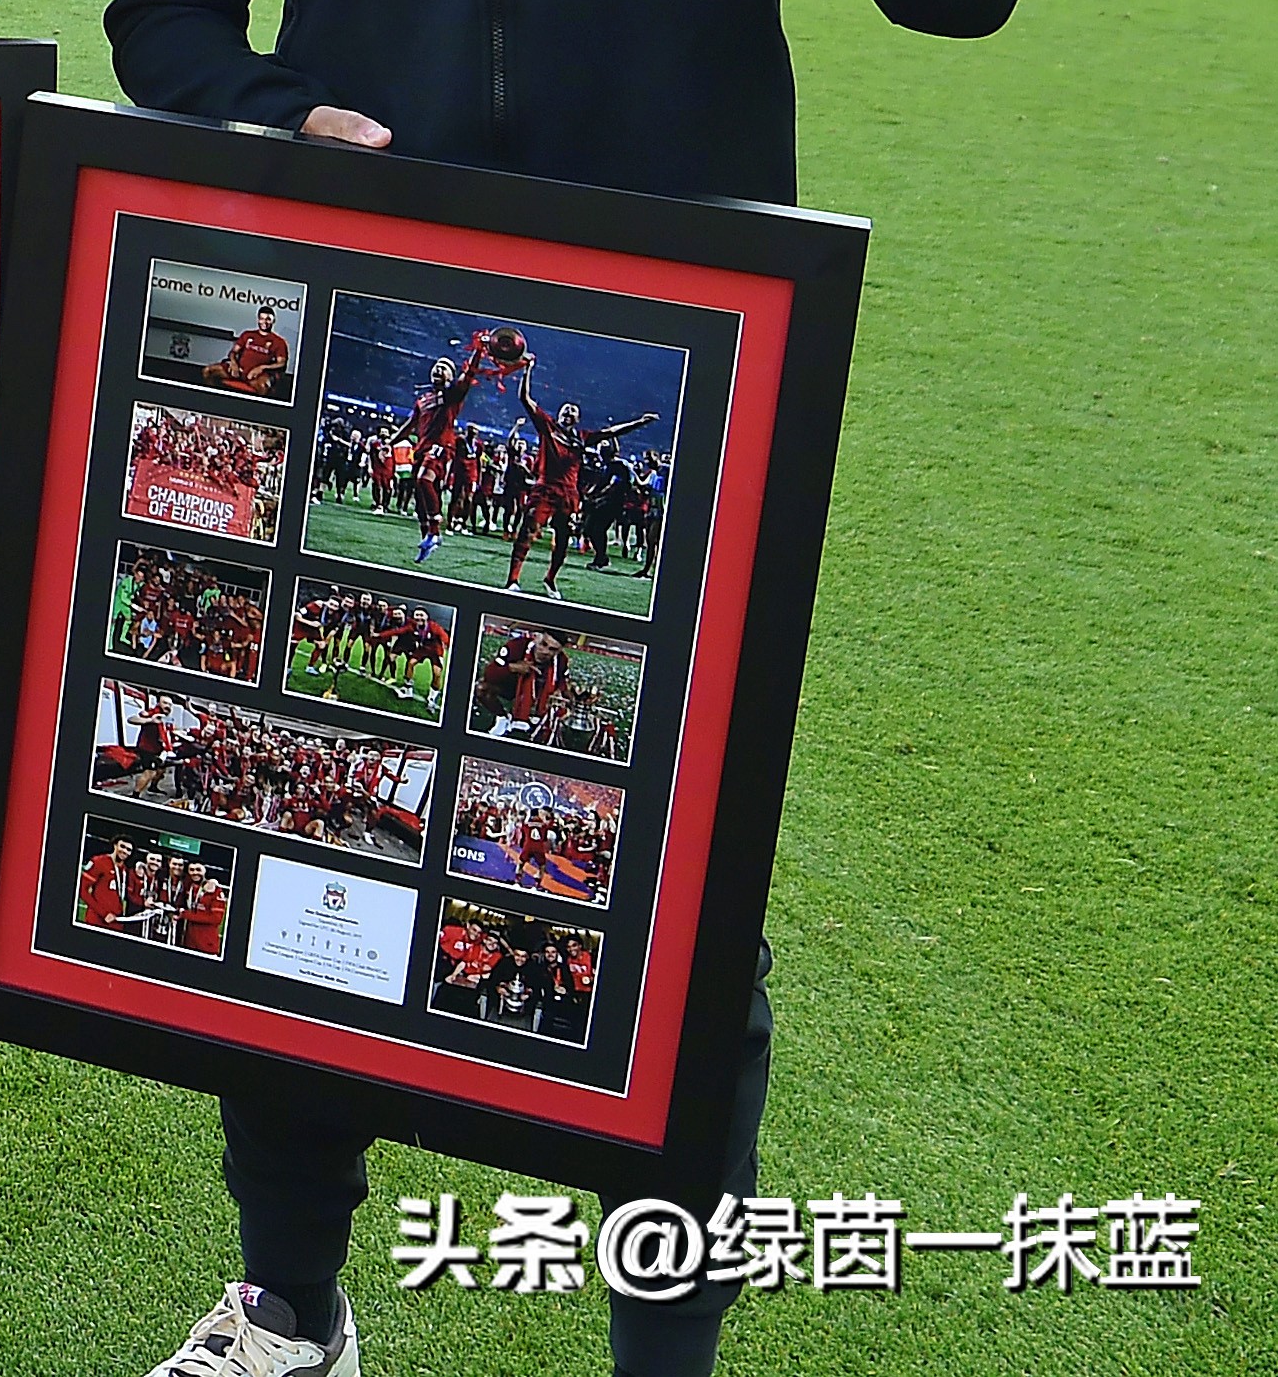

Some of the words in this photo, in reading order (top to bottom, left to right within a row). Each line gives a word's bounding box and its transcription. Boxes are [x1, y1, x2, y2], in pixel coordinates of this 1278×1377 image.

[198, 282, 215, 297] to
[219, 285, 301, 312] Melwood
[147, 484, 235, 520] CHAMPIONS
[148, 500, 170, 517] OF
[171, 505, 229, 533] EUROPE
